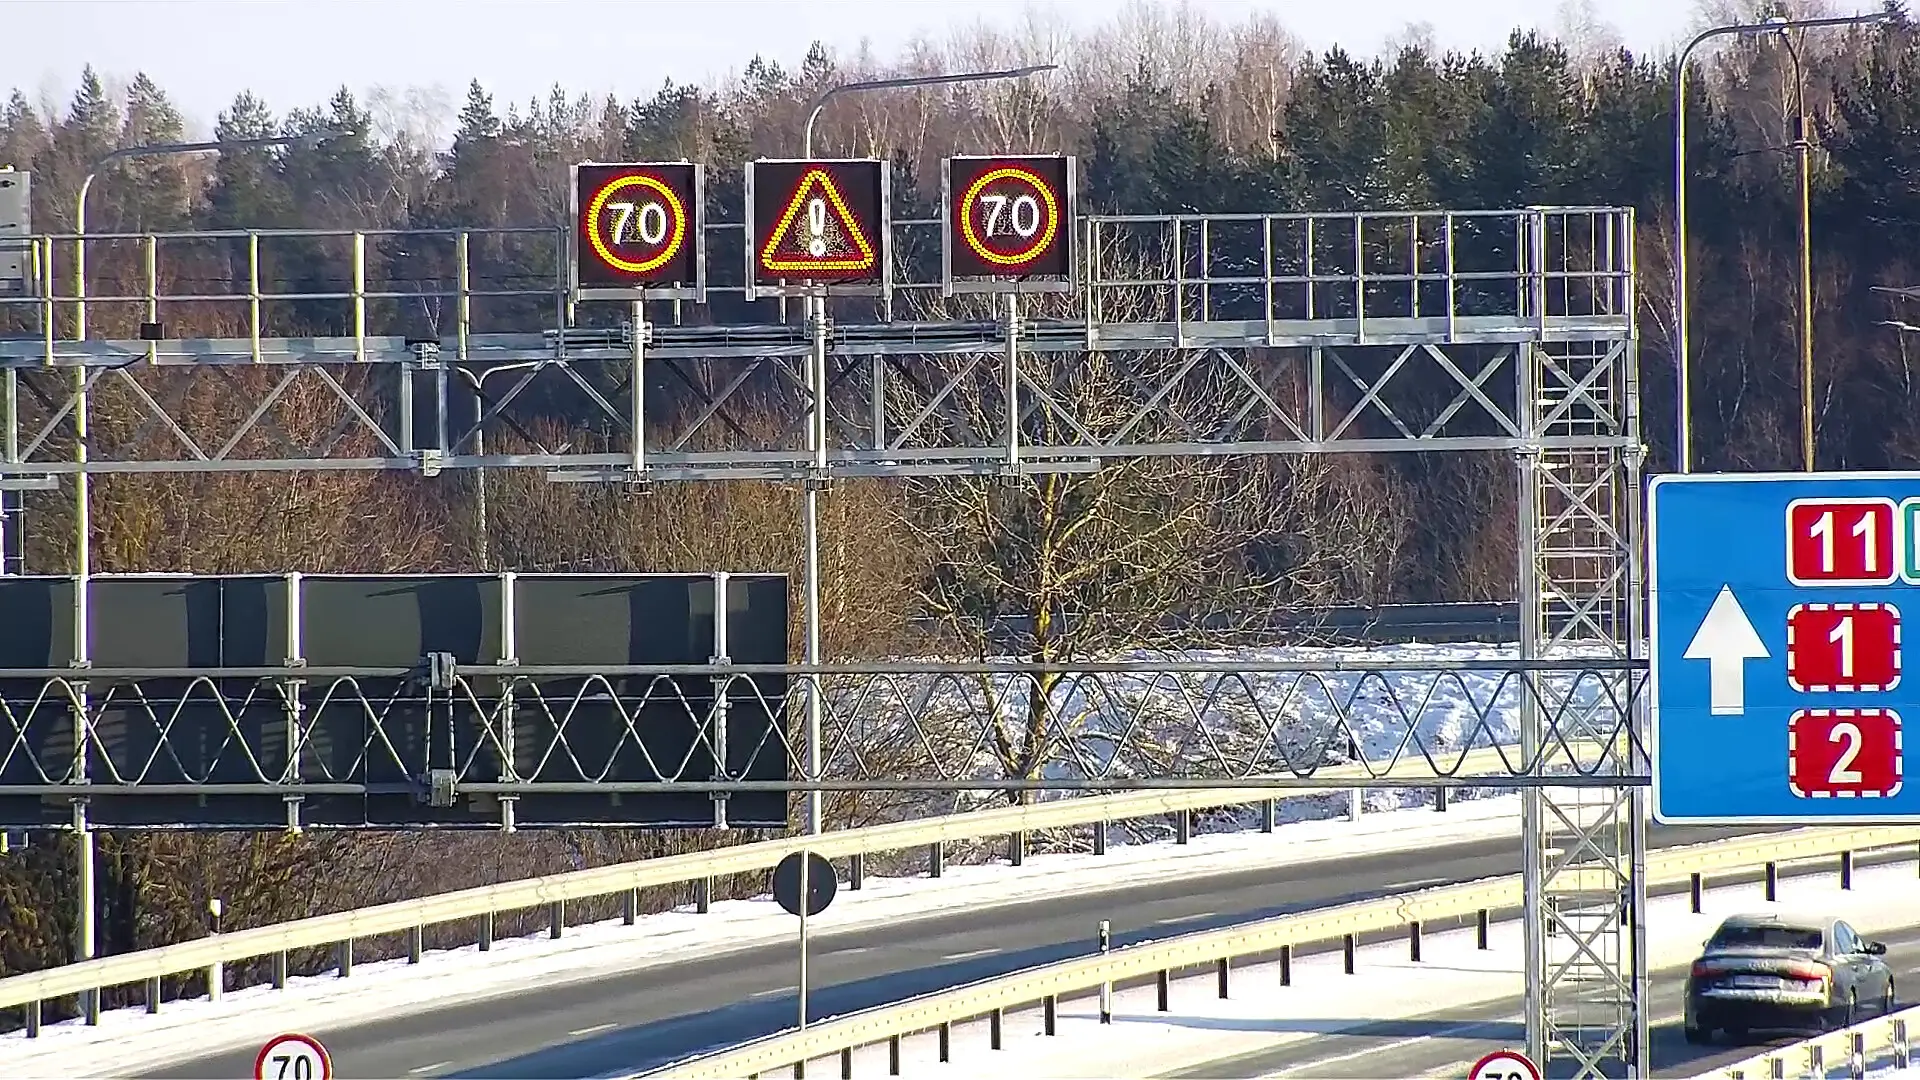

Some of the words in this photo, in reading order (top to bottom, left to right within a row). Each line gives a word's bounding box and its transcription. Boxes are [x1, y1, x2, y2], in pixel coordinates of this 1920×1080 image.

[606, 202, 667, 246] 70
[980, 194, 1040, 238] 70
[1809, 510, 1877, 573] 11
[1828, 616, 1854, 678] 1
[1827, 722, 1863, 784] 2
[272, 1054, 312, 1080] 70
